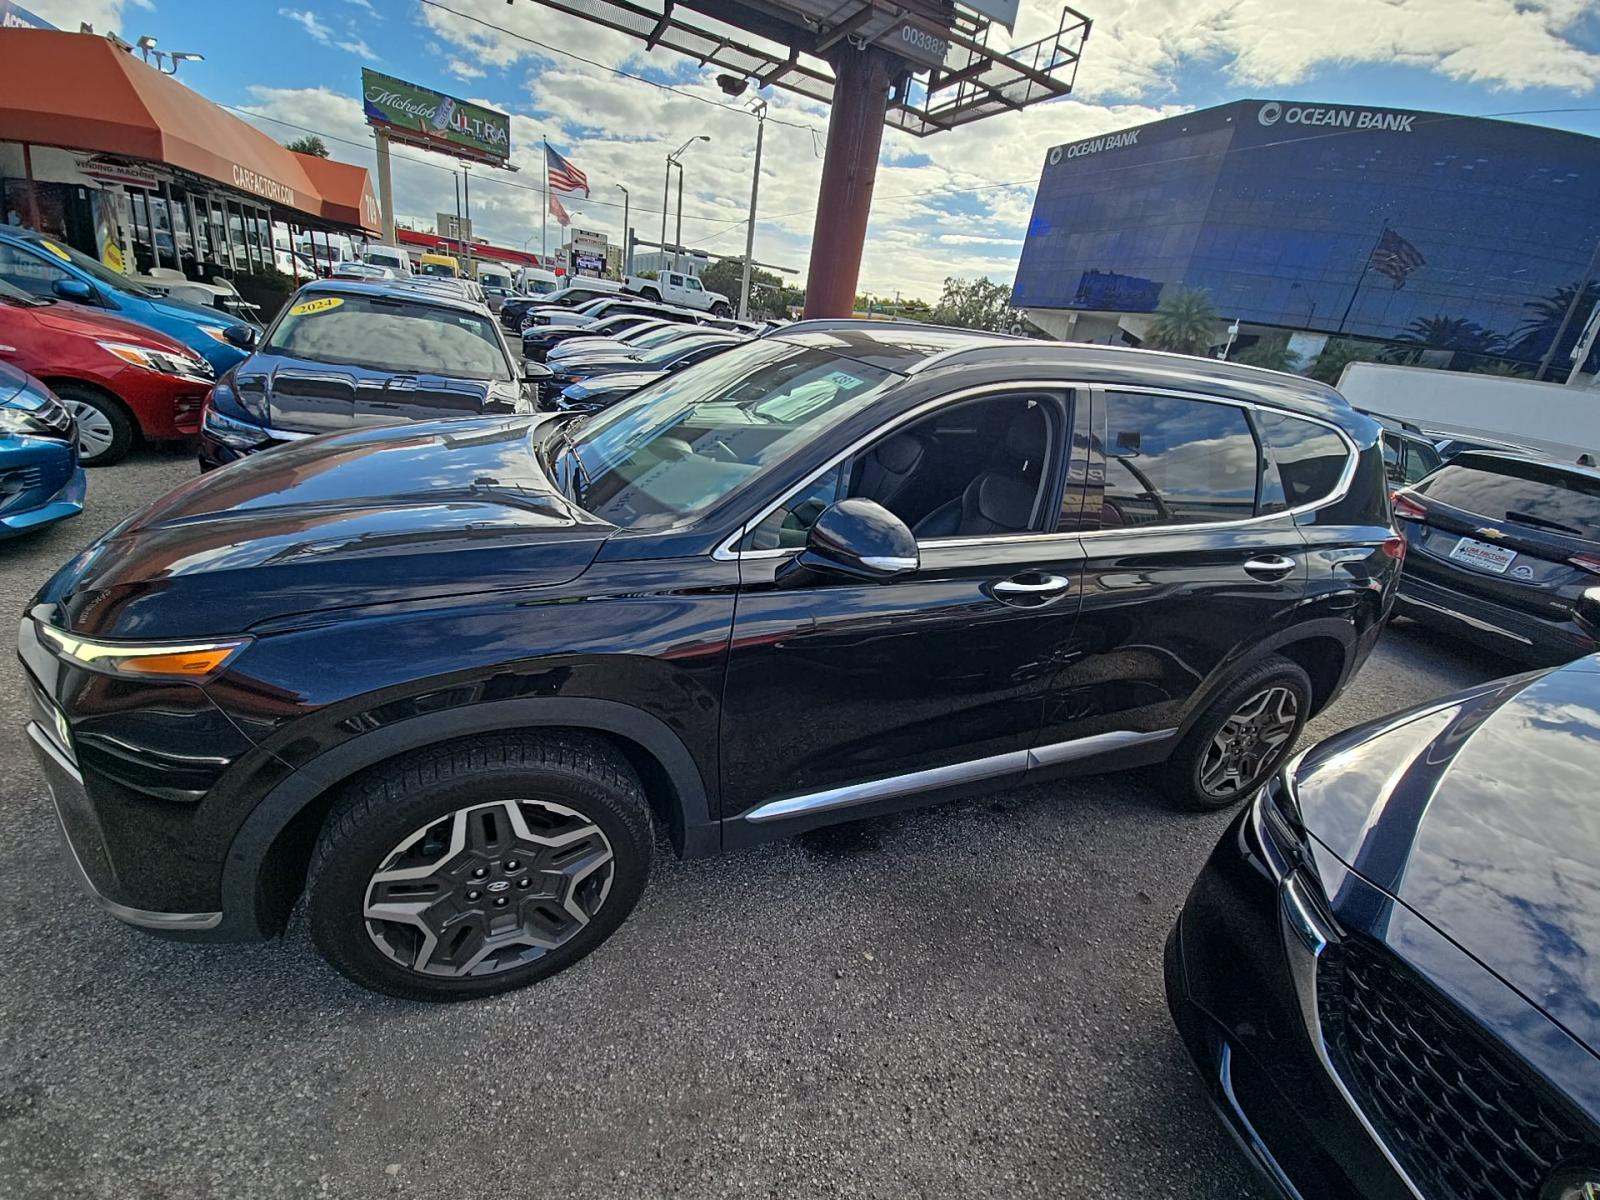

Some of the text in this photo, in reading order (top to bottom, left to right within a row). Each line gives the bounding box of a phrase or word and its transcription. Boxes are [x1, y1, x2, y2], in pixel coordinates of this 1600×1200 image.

[903, 25, 946, 57] 003382
[365, 86, 437, 119] Michelob
[450, 112, 508, 143] ULTRA
[1285, 107, 1416, 132] OCEAN BANK
[1067, 129, 1141, 158] OCEAN BANK
[74, 160, 113, 172] VENDING
[232, 165, 294, 205] CARFACTORY.COM
